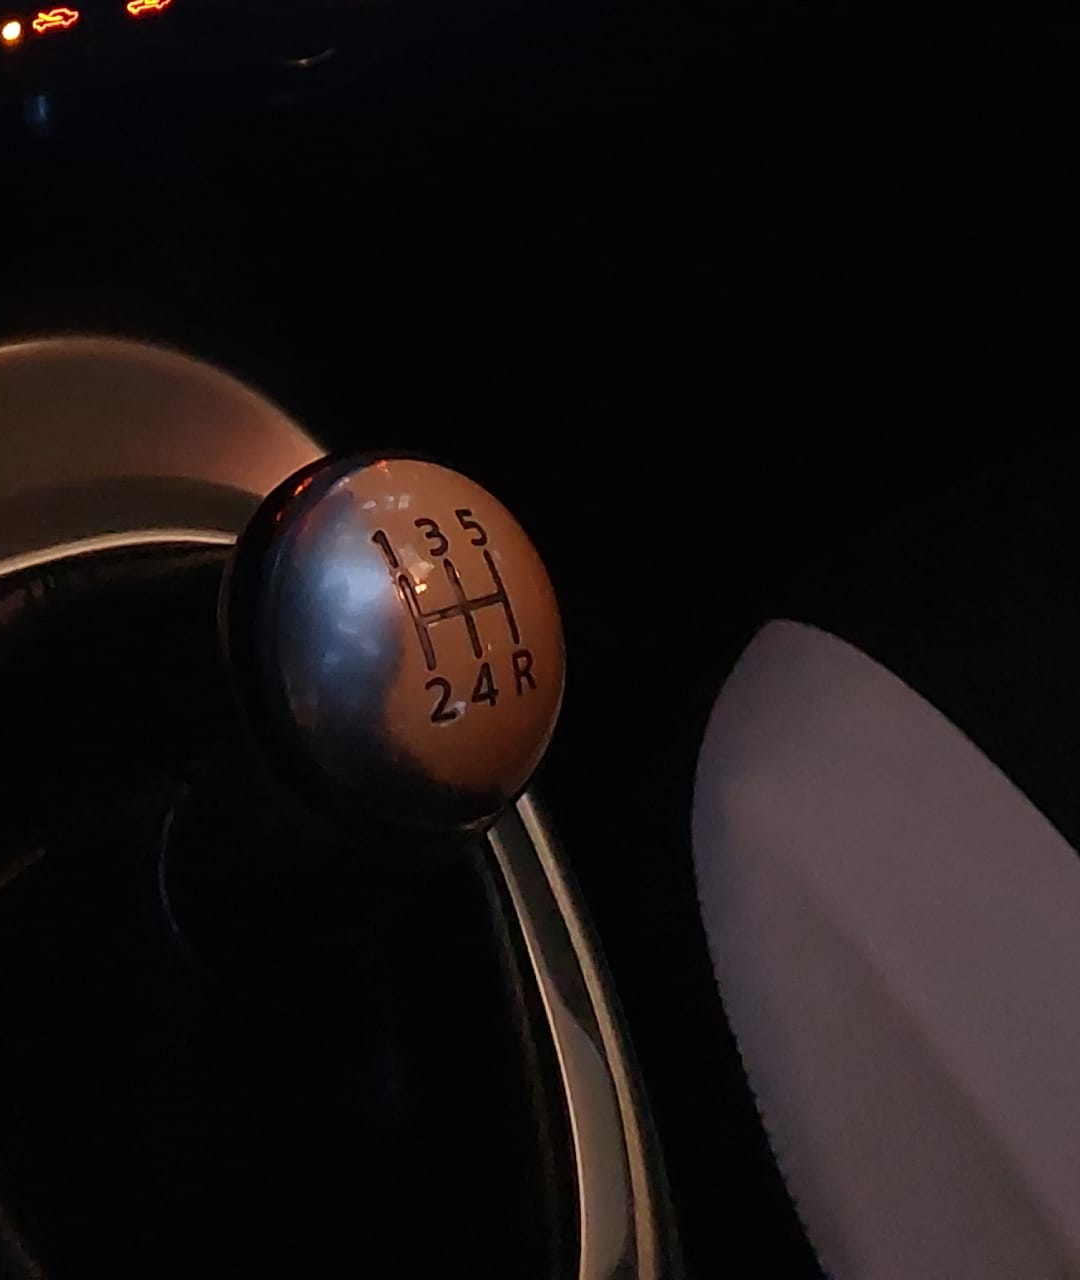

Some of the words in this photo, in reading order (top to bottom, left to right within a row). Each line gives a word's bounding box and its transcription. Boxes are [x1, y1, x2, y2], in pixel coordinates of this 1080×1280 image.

[372, 530, 399, 567] 1
[414, 518, 449, 556] 3
[455, 509, 488, 546] 5
[425, 677, 457, 723] 2
[471, 662, 499, 707] 4
[512, 649, 537, 696] R
